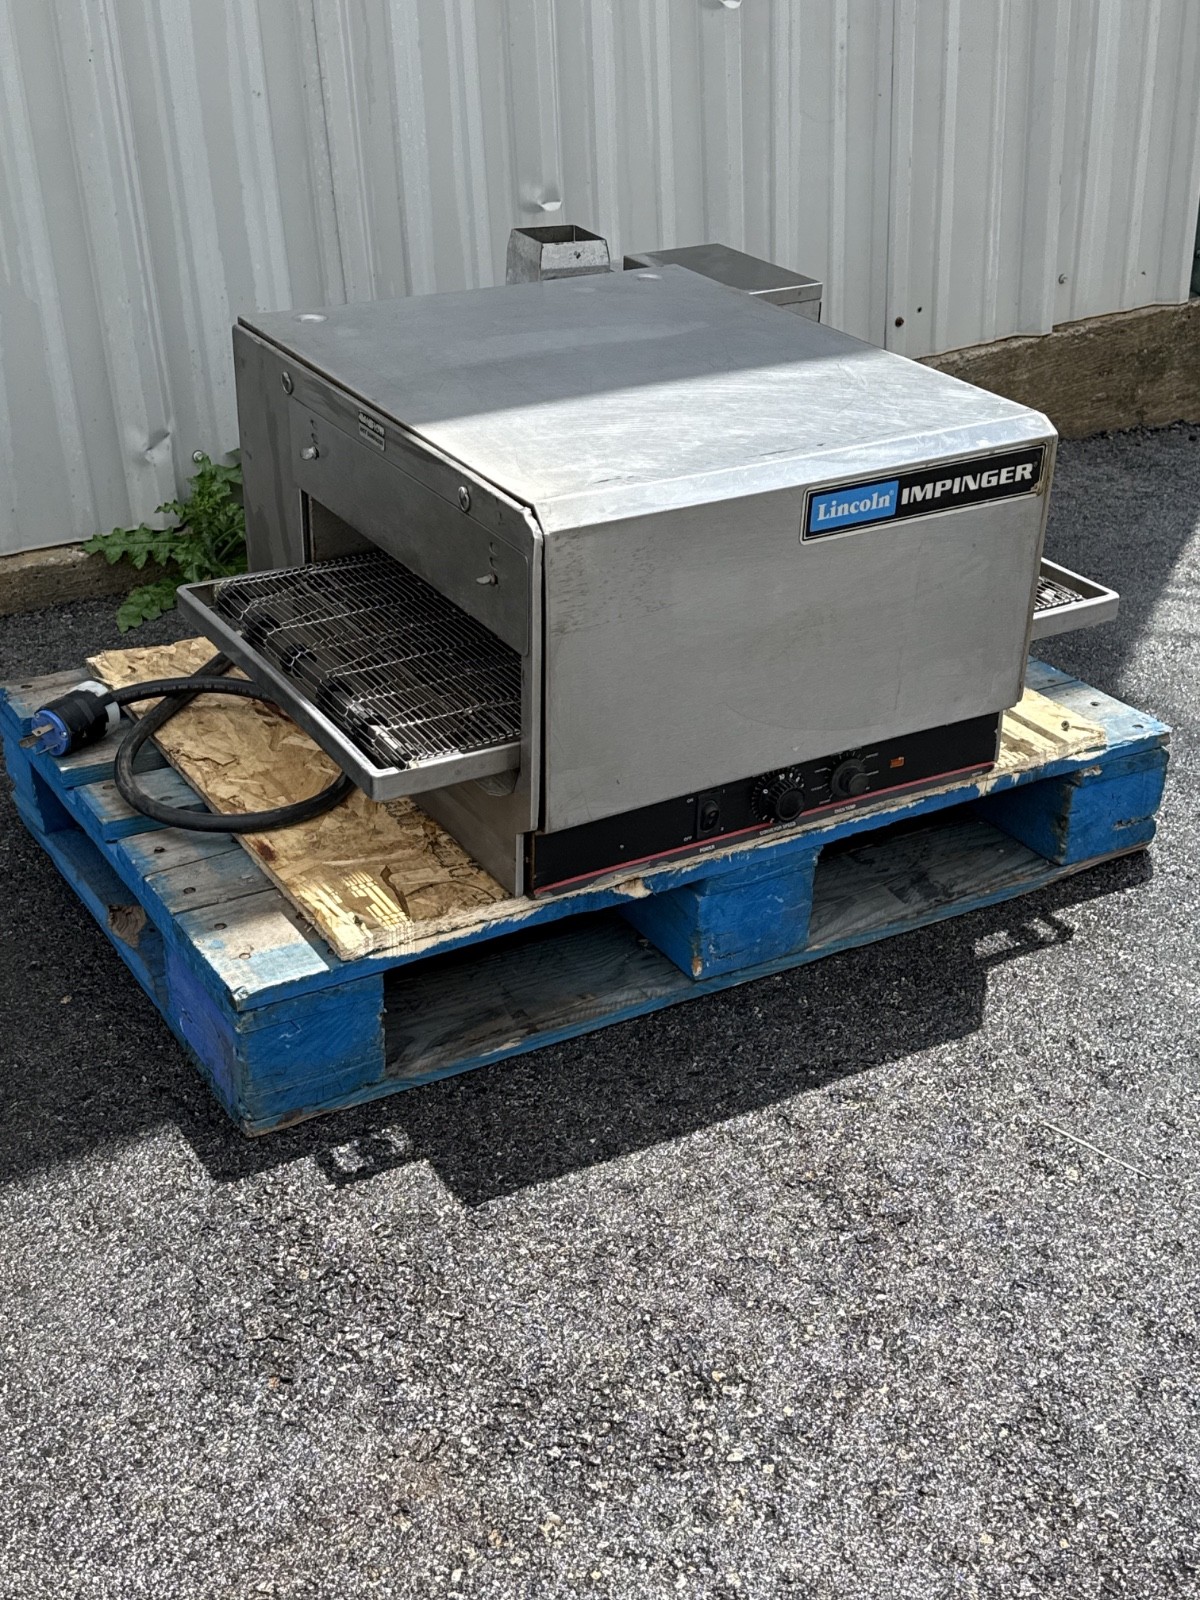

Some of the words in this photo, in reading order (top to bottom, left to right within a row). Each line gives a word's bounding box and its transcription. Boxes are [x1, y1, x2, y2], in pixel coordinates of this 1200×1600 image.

[817, 491, 891, 521] Lincoln
[901, 463, 1034, 505] IMPINGER
[699, 844, 716, 853] POWER
